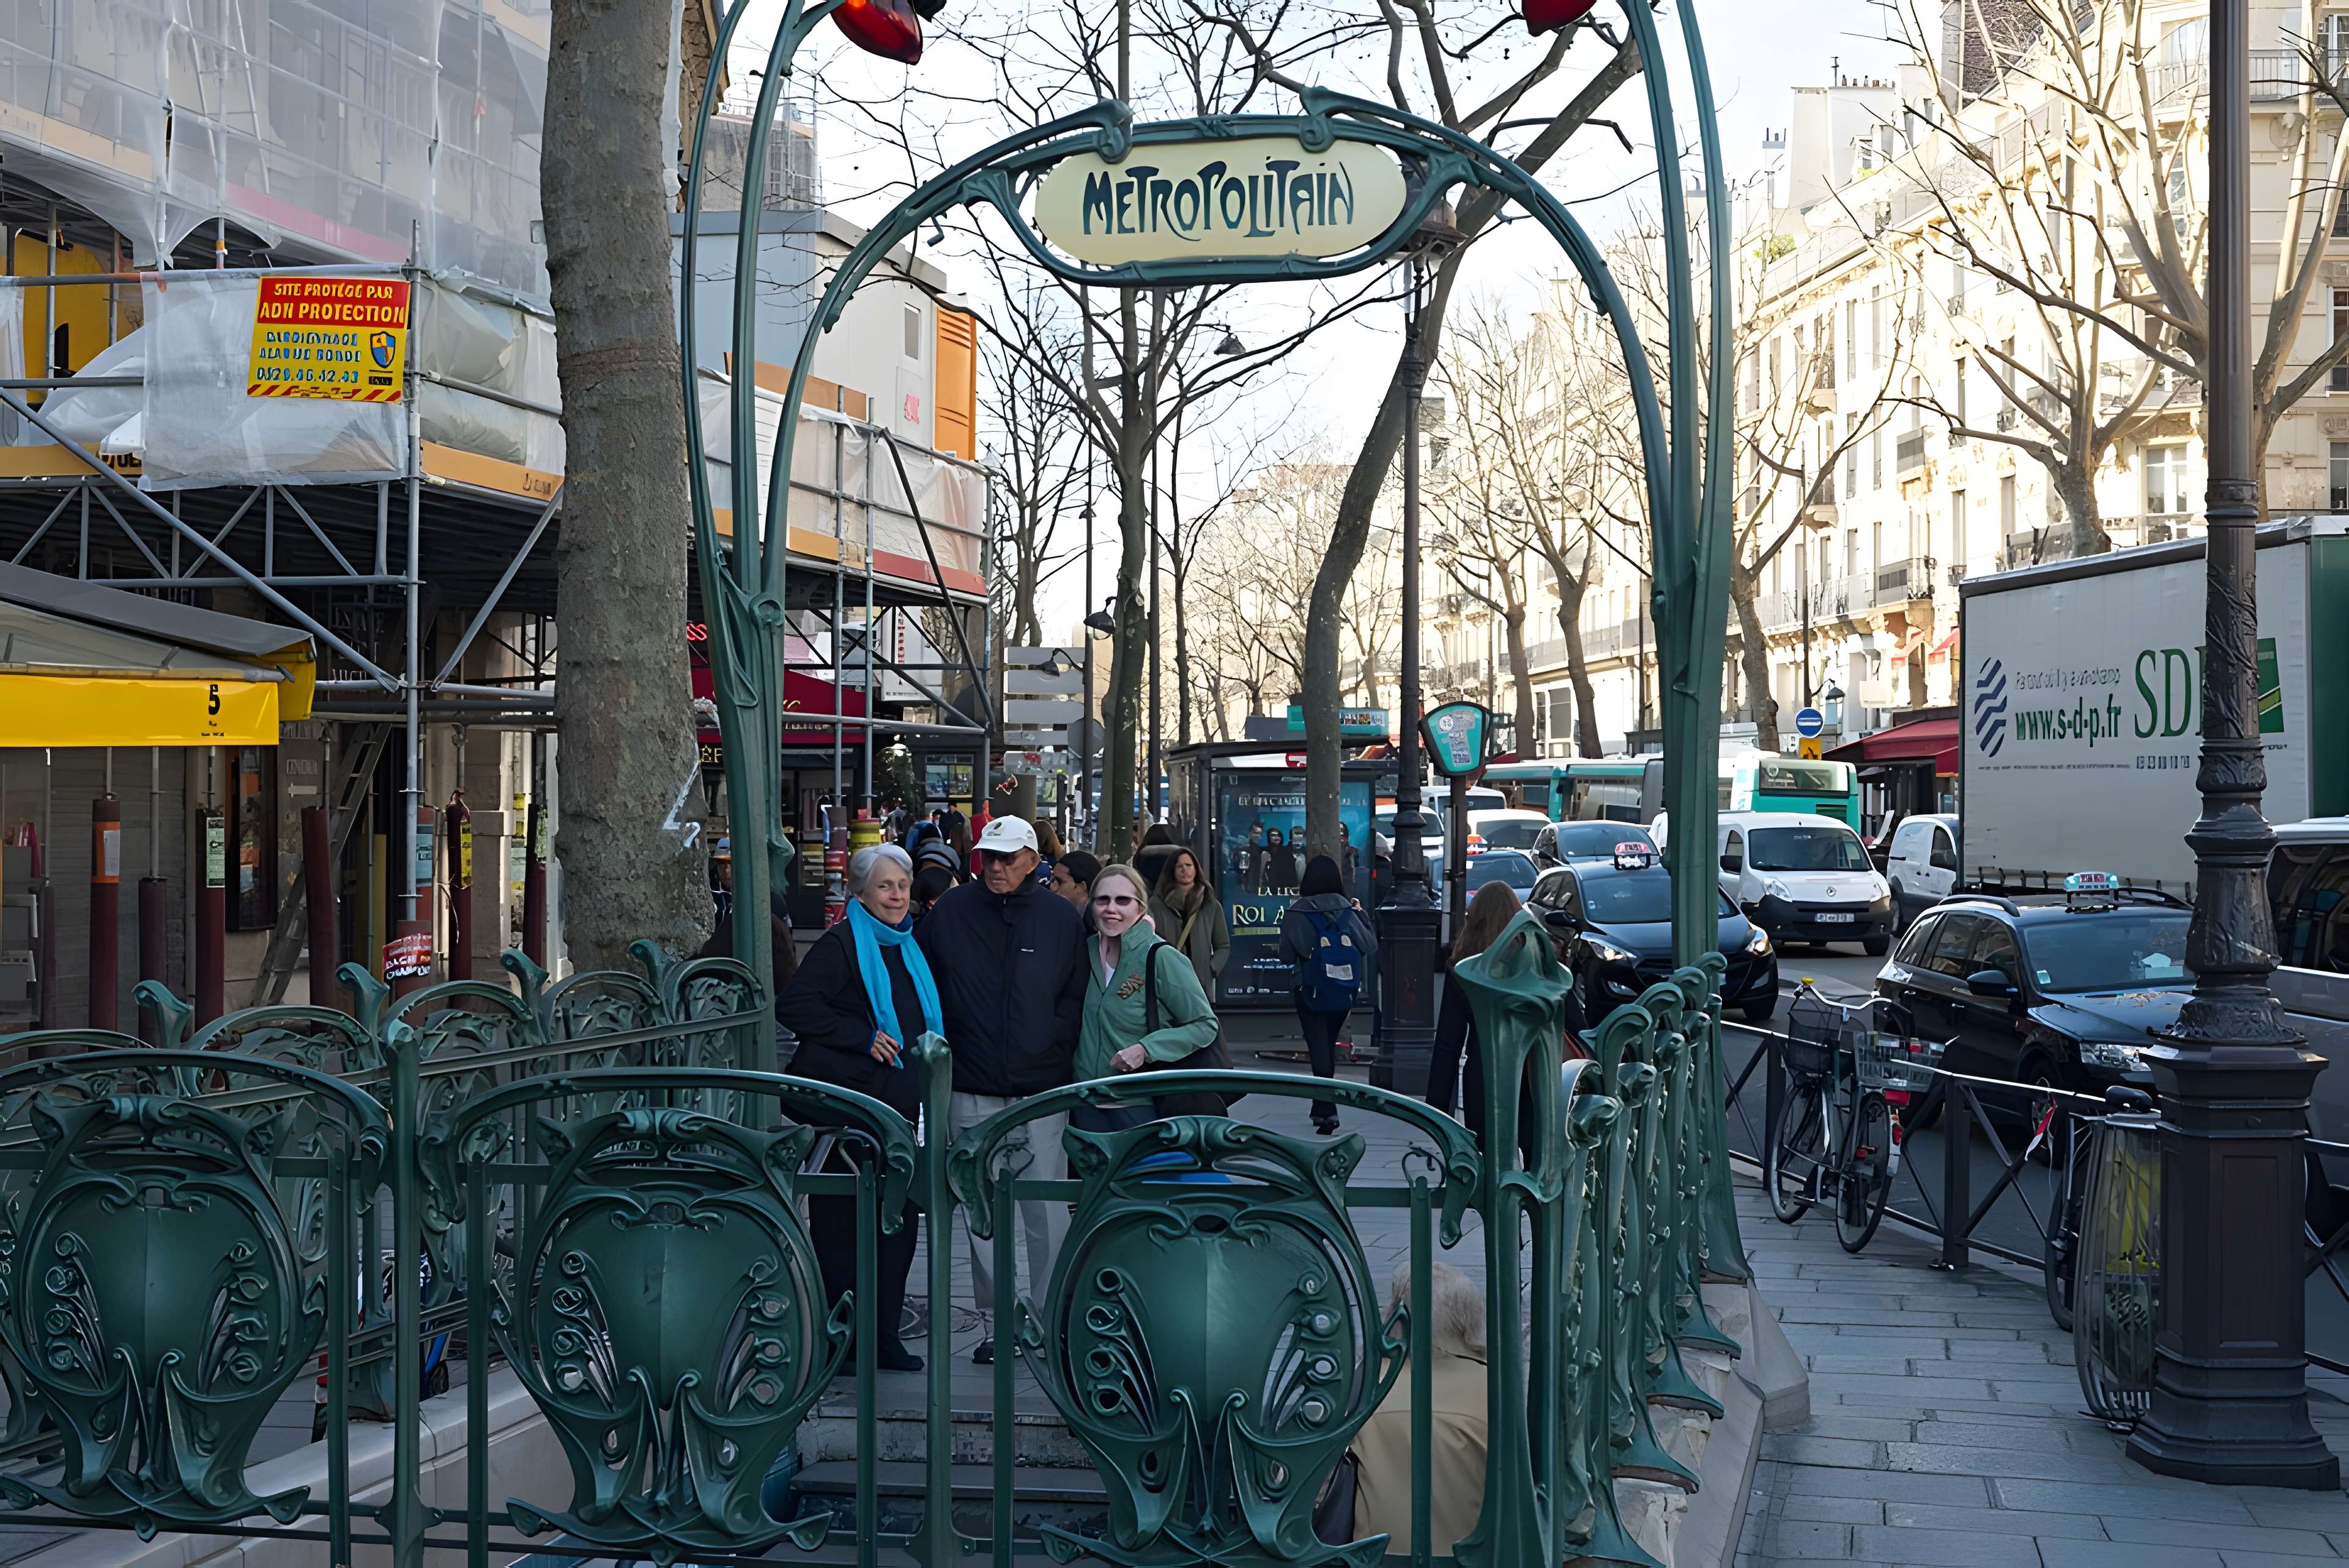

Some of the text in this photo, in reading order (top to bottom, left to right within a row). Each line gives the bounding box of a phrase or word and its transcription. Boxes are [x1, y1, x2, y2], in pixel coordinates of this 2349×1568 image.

[1082, 155, 1354, 242] METROPOLITAIN
[274, 283, 302, 296] SITE
[259, 301, 405, 324] ADN PROTECTION
[208, 684, 221, 716] 5
[2015, 693, 2121, 748] www.s-d-p.fr
[1233, 904, 1265, 925] ROI
